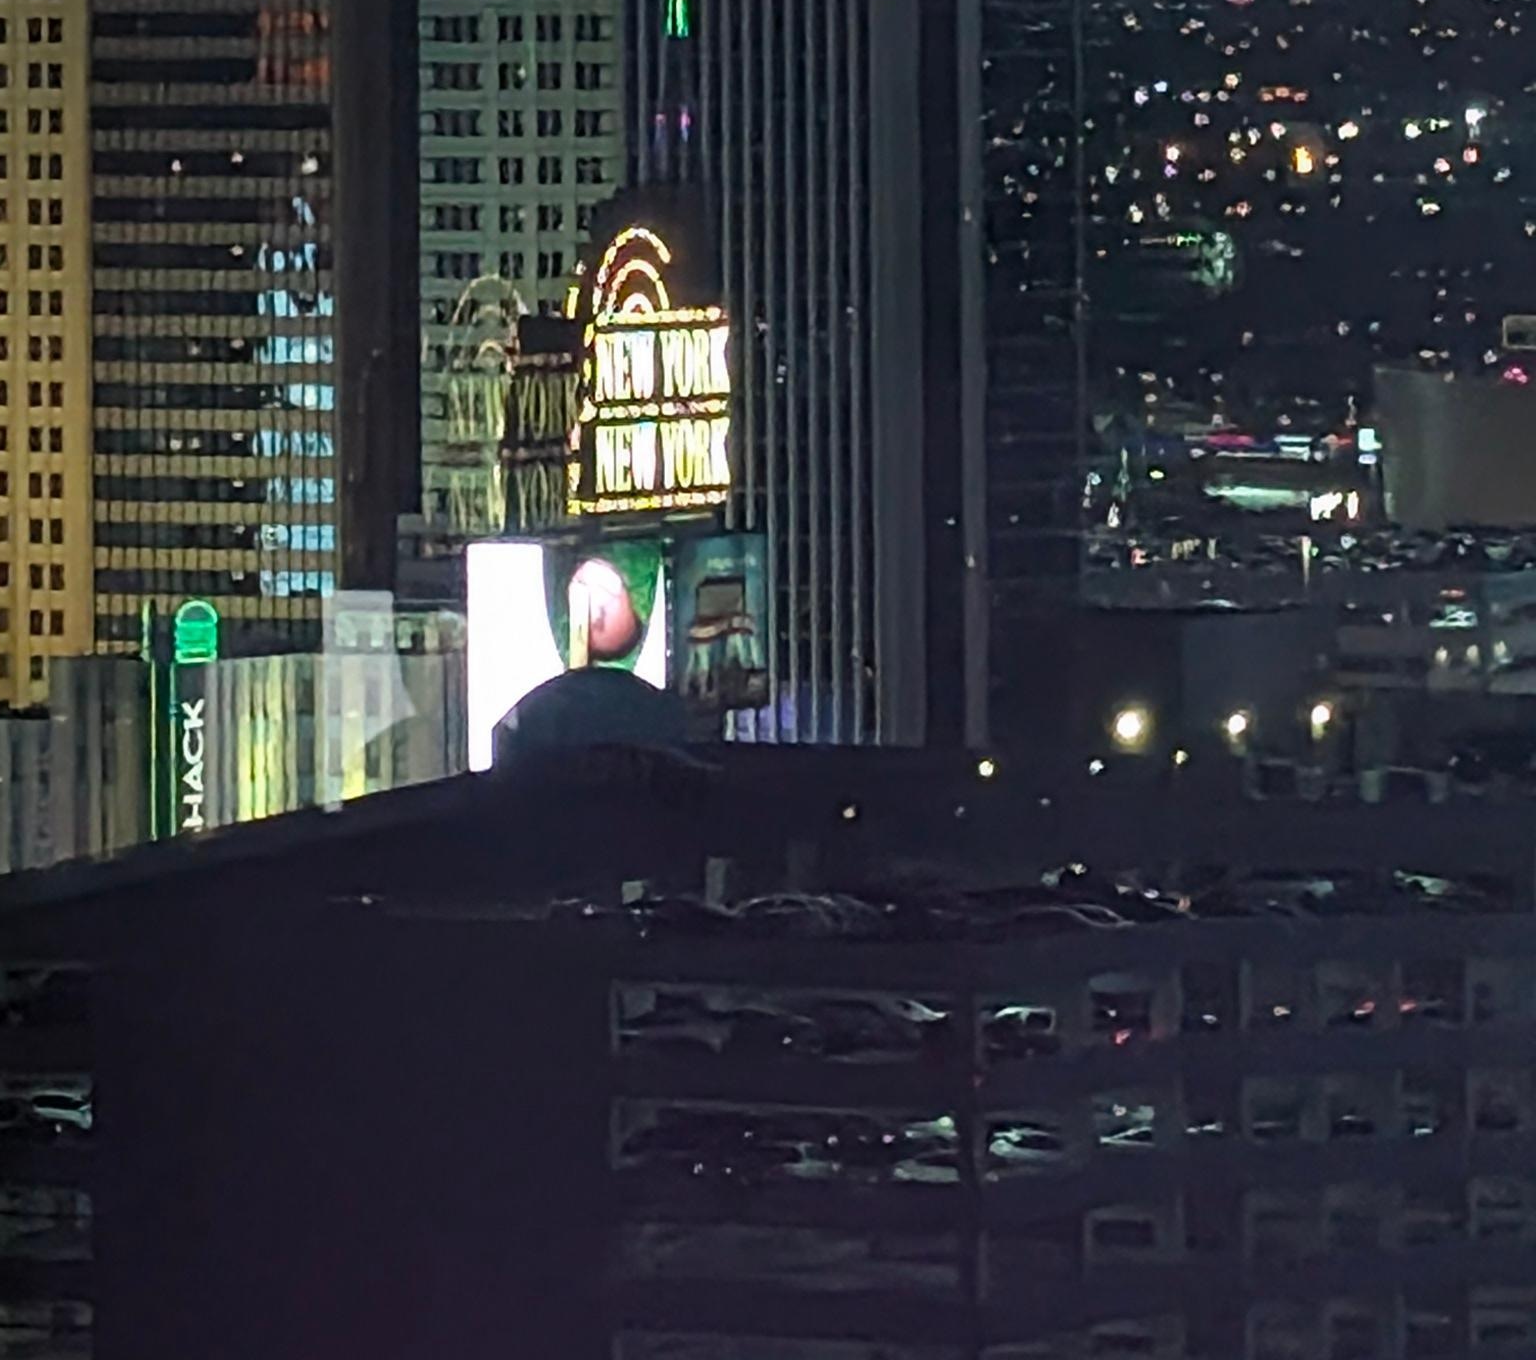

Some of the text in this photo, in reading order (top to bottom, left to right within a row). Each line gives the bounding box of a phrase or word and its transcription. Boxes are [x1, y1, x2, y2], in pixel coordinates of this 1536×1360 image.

[595, 325, 731, 403] NEW YORK
[595, 417, 731, 493] NEW YORK
[181, 698, 205, 832] HACK
